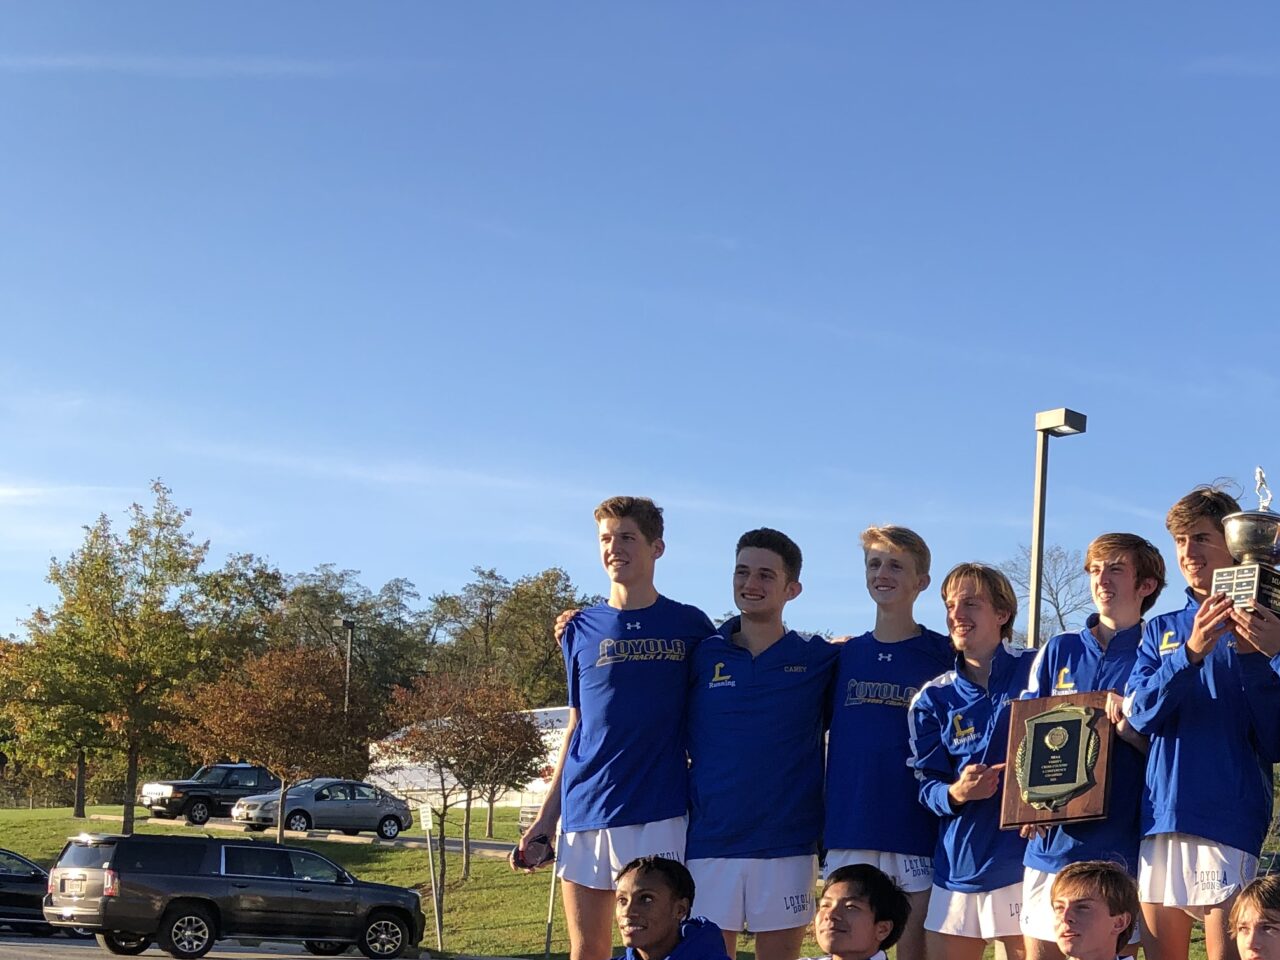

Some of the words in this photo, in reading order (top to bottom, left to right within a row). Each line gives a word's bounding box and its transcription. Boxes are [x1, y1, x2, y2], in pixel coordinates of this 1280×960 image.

[596, 638, 686, 668] LOYOLA
[708, 680, 736, 689] Running
[912, 868, 931, 877] DONS
[1194, 870, 1228, 886] LOYOLA
[1202, 881, 1221, 891] DONS
